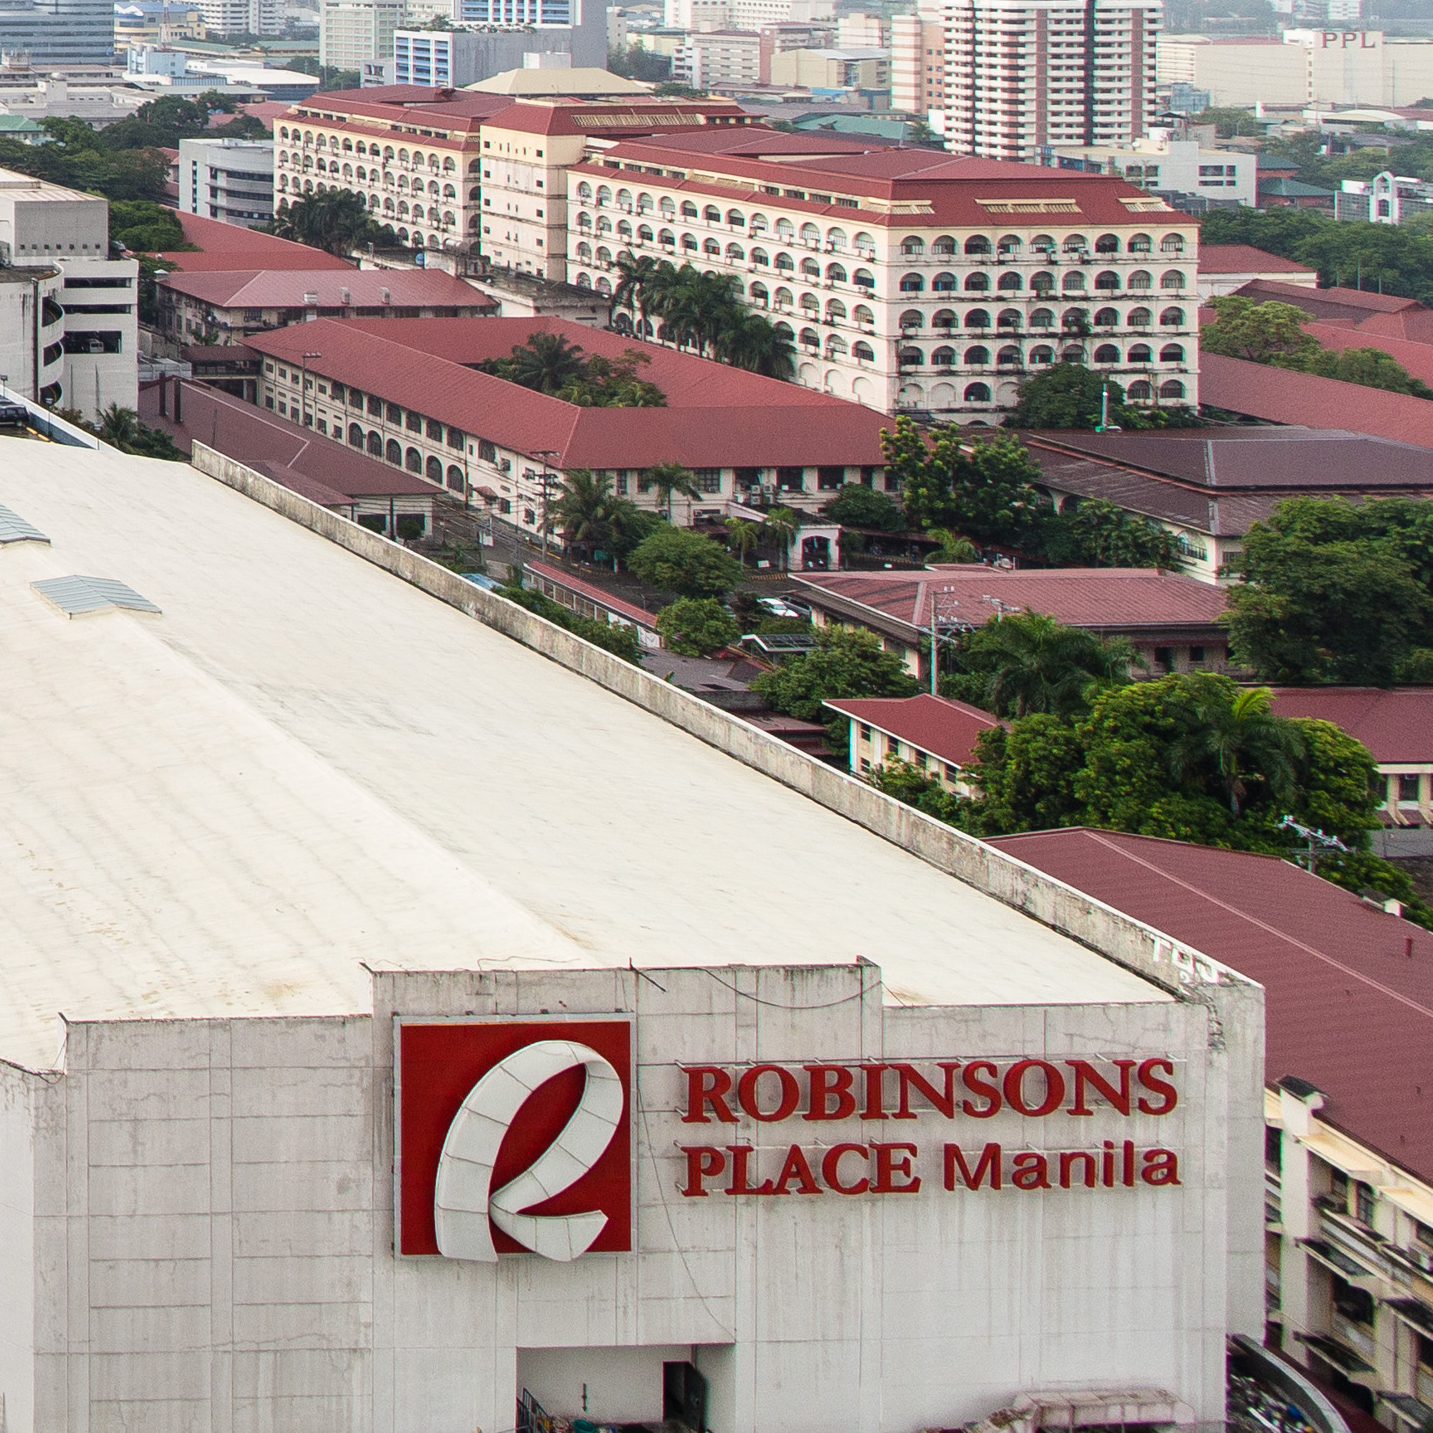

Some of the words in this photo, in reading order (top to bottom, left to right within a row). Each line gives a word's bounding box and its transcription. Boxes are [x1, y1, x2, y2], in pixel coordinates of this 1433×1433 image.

[1321, 31, 1376, 49] PPL
[680, 1057, 1179, 1124] ROBINSONS
[678, 1142, 921, 1198] PLACE
[942, 1140, 1182, 1192] Manila
